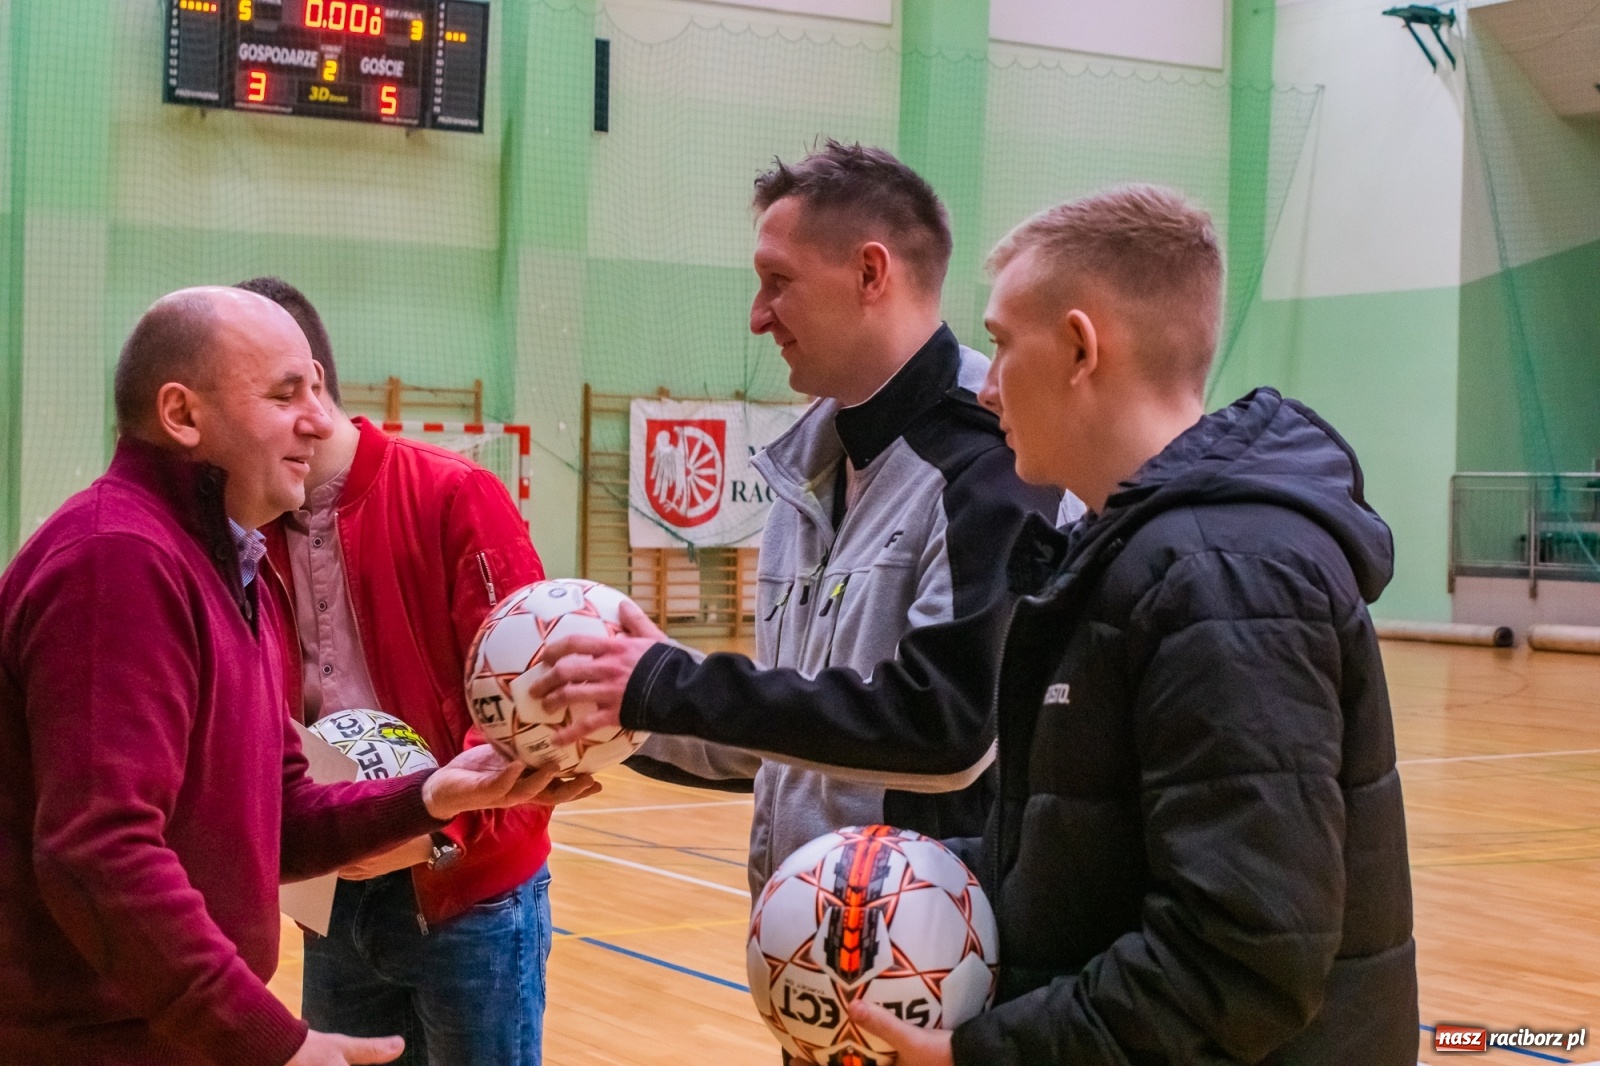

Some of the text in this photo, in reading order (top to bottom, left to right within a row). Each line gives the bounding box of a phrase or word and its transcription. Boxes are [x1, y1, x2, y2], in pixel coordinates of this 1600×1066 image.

[410, 20, 423, 41] 3
[239, 43, 318, 68] GOSPODARZE
[360, 54, 405, 77] GOŚCIE
[323, 60, 337, 81] 2
[248, 72, 267, 102] 3
[380, 86, 397, 115] 5
[330, 713, 365, 739] ECT
[780, 984, 840, 1030] ECT
